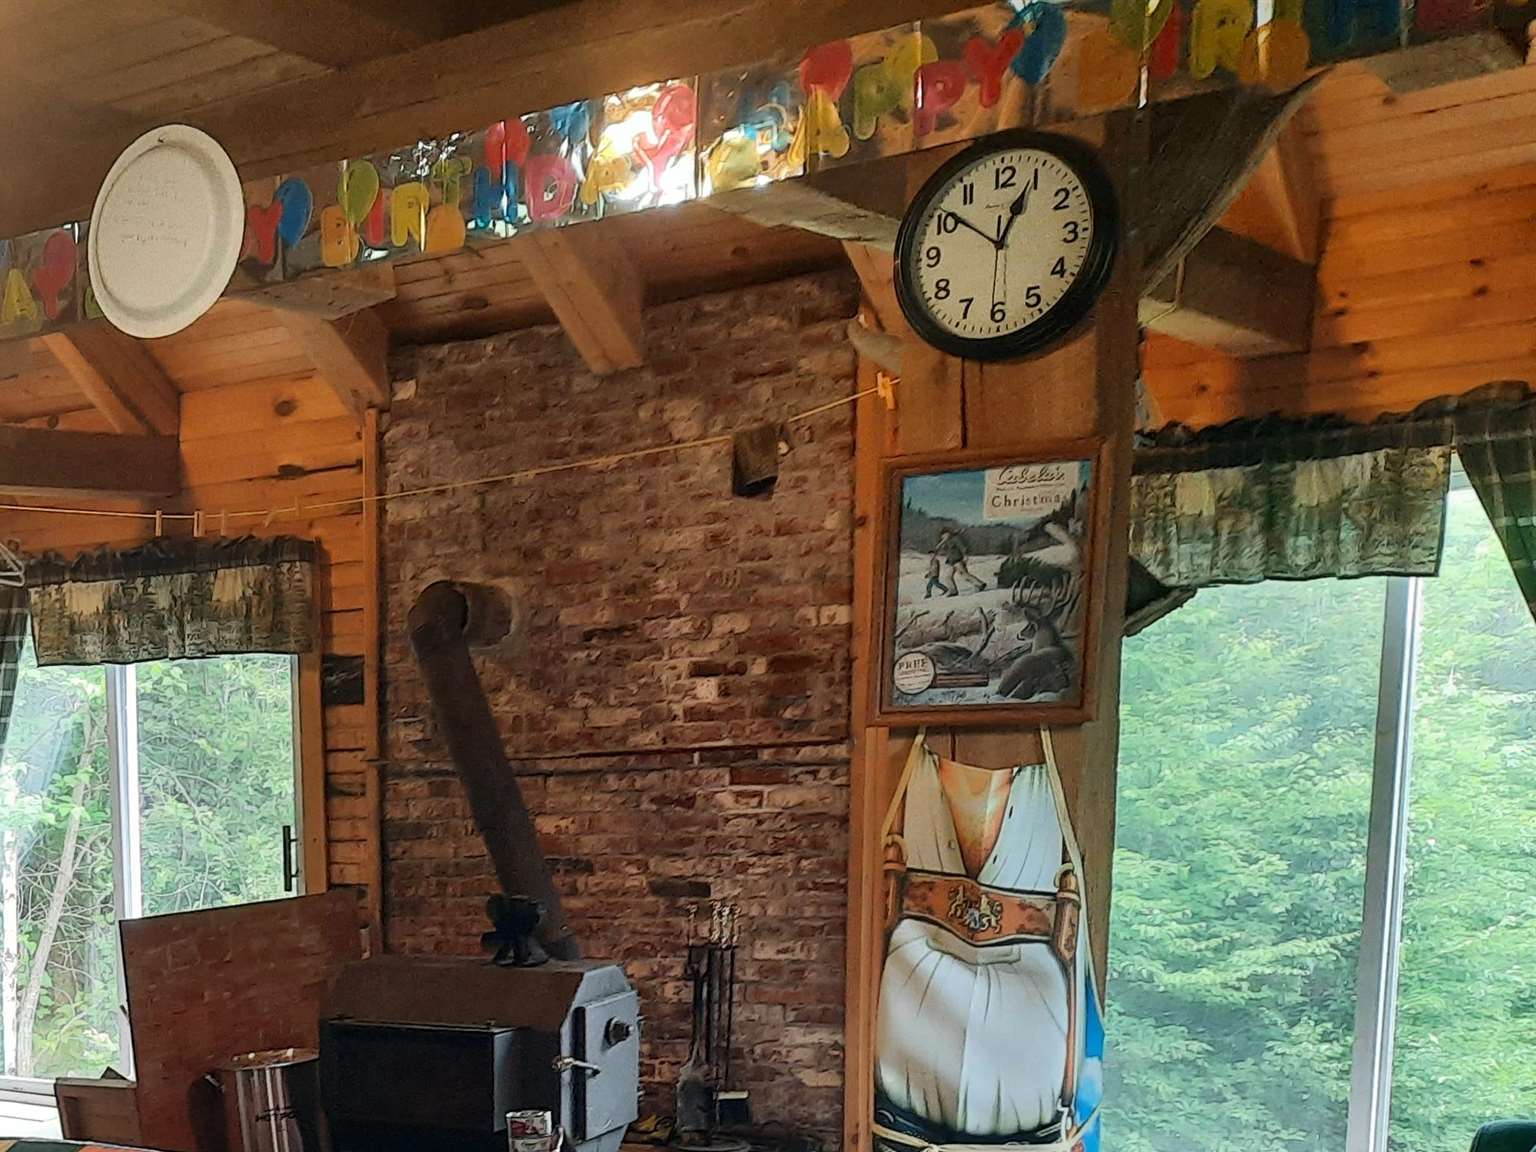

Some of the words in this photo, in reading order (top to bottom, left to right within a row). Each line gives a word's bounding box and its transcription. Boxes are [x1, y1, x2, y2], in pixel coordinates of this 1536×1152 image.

[994, 165, 1017, 190] 12
[1033, 168, 1039, 190] 1
[963, 182, 974, 205] 11
[1052, 187, 1070, 211] 2
[936, 212, 959, 235] 10
[1062, 221, 1078, 243] 3
[926, 246, 941, 268] 9
[1050, 256, 1067, 279] 4
[934, 278, 950, 300] 8
[1025, 285, 1041, 308] 5
[959, 297, 974, 320] 7
[990, 301, 1006, 323] 6
